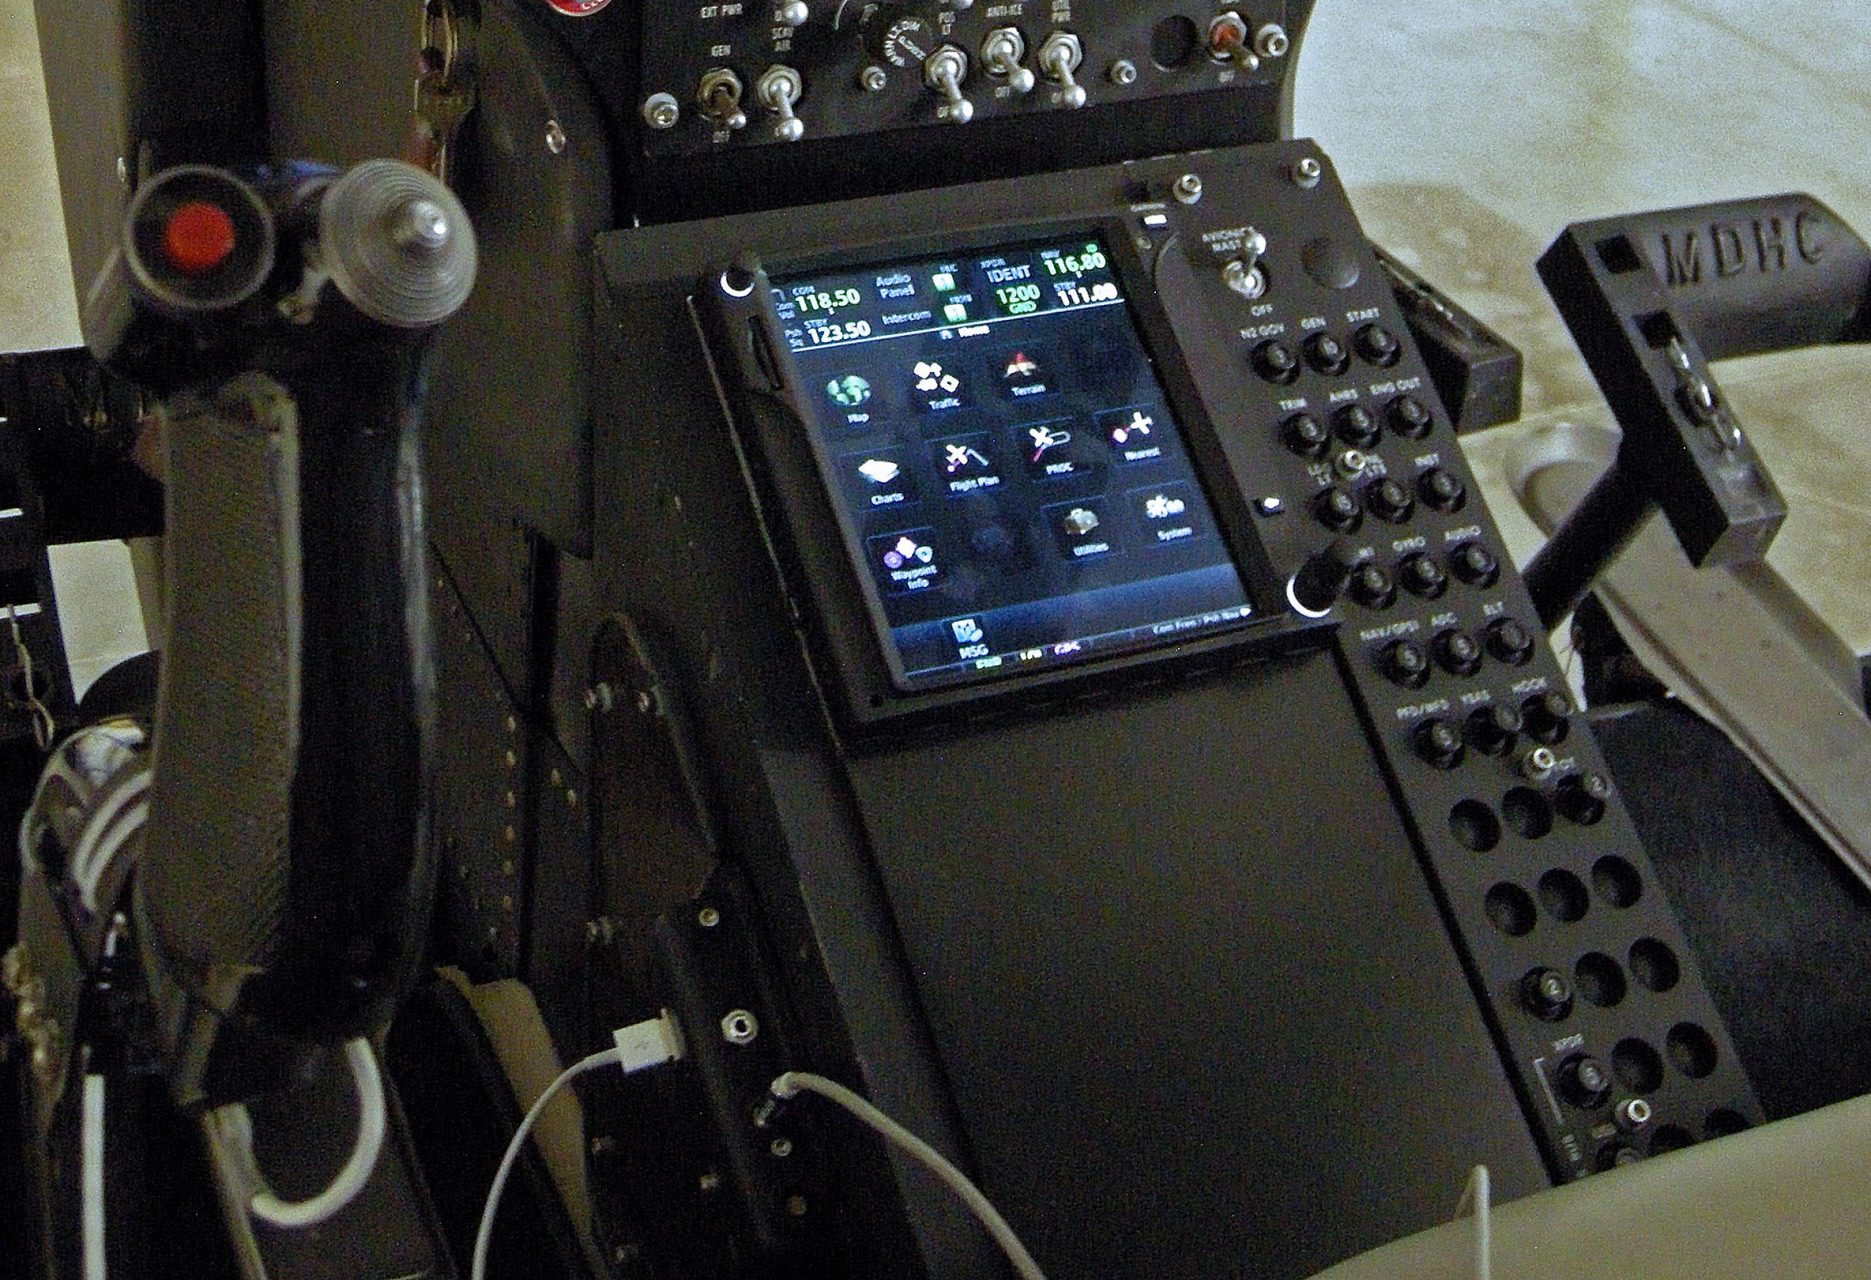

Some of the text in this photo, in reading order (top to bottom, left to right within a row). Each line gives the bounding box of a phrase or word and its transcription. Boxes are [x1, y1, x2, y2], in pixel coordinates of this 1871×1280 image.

[700, 3, 743, 19] EXT PWR
[986, 4, 1023, 17] ANTI-ICE
[711, 44, 731, 56] GEN
[1661, 211, 1824, 286] MDHC
[1044, 252, 1107, 276] 116.80
[876, 273, 911, 288] Audio
[987, 264, 1031, 283] IDENT
[878, 285, 916, 299] Panel
[995, 284, 1041, 304] 1200
[794, 287, 861, 313] 118.50
[1008, 301, 1037, 315] GND
[882, 310, 932, 325] Intercom
[806, 320, 872, 346] 123.50
[1012, 385, 1046, 398] Terrain
[929, 397, 961, 410] Traffic
[950, 474, 999, 493] Flight Plan
[872, 492, 904, 506] Charts
[1157, 525, 1193, 542] System
[890, 564, 937, 582] Waypoint
[907, 577, 930, 591] Info
[959, 643, 989, 658] MSG
